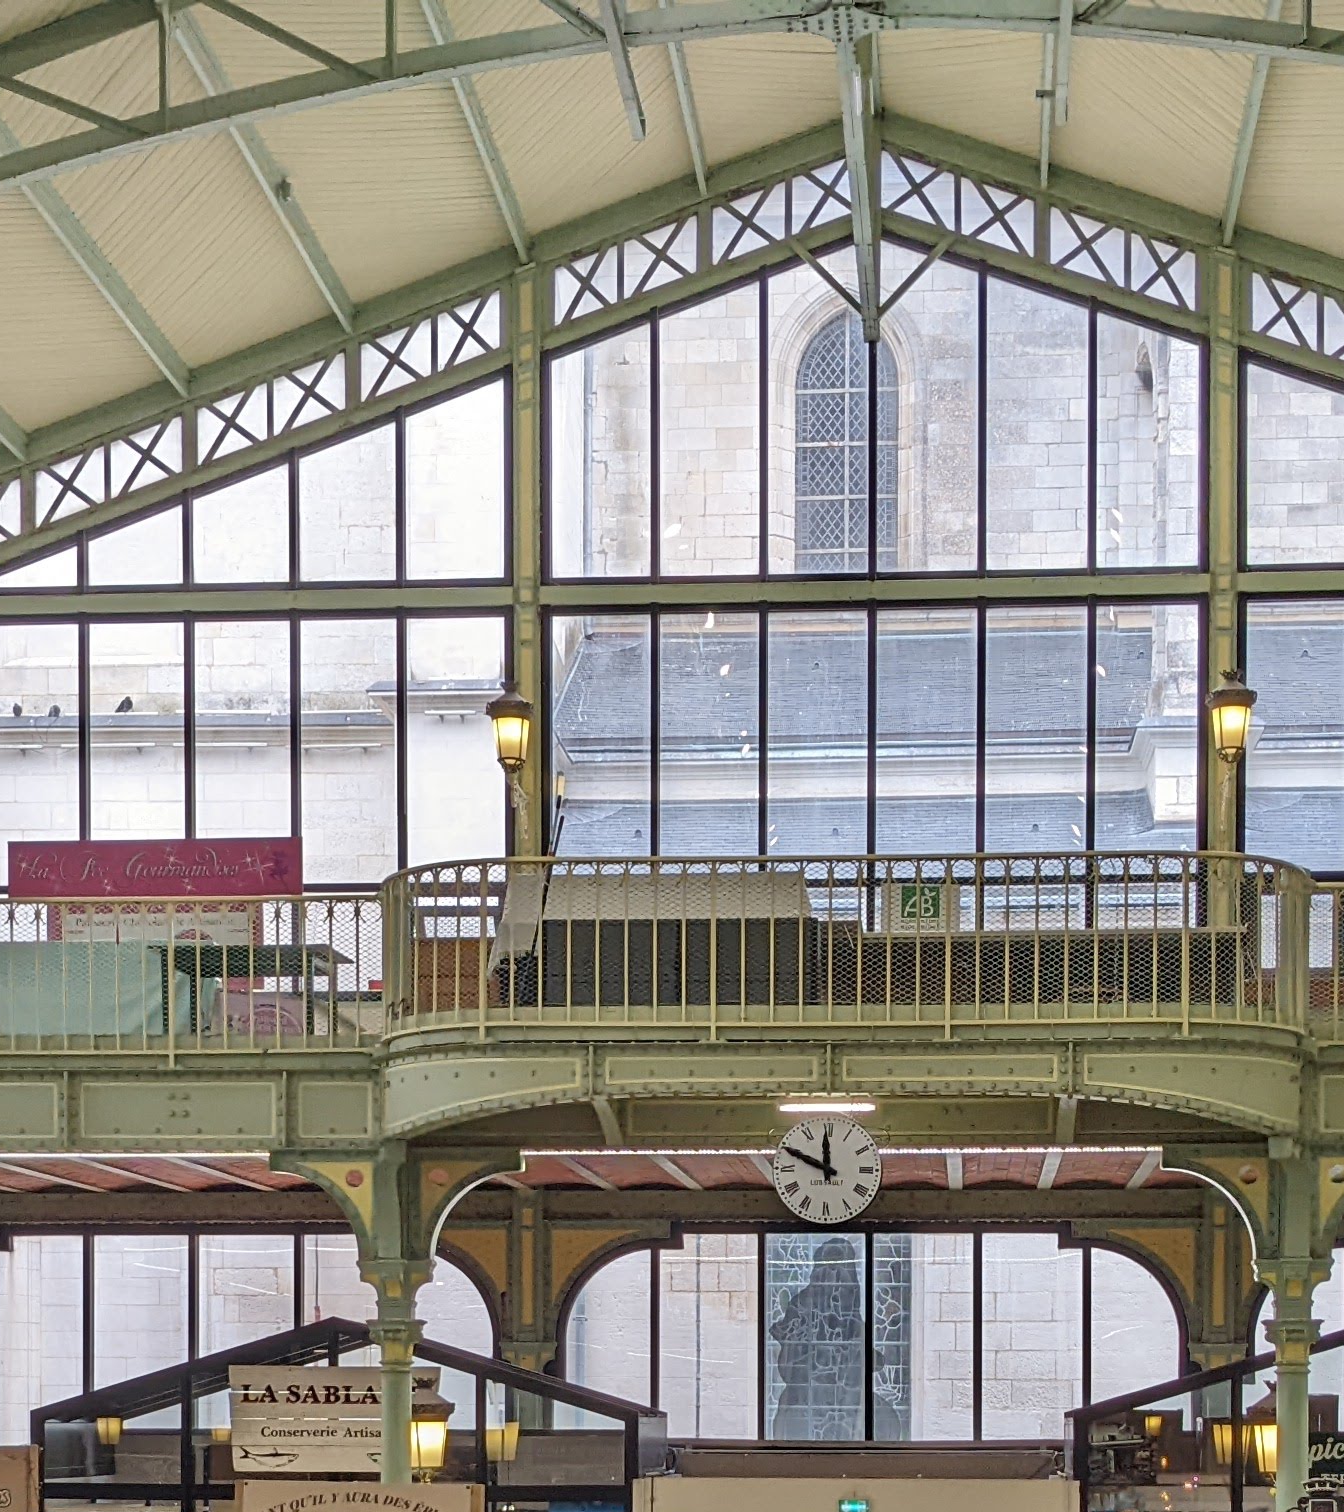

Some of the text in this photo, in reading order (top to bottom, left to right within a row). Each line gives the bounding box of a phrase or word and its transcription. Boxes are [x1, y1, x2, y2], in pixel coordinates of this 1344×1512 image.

[240, 1384, 382, 1405] LA SABLA
[260, 1425, 382, 1438] Conserverie Artisa
[331, 1492, 338, 1504] Y
[344, 1491, 379, 1505] AURA
[382, 1495, 411, 1511] DES
